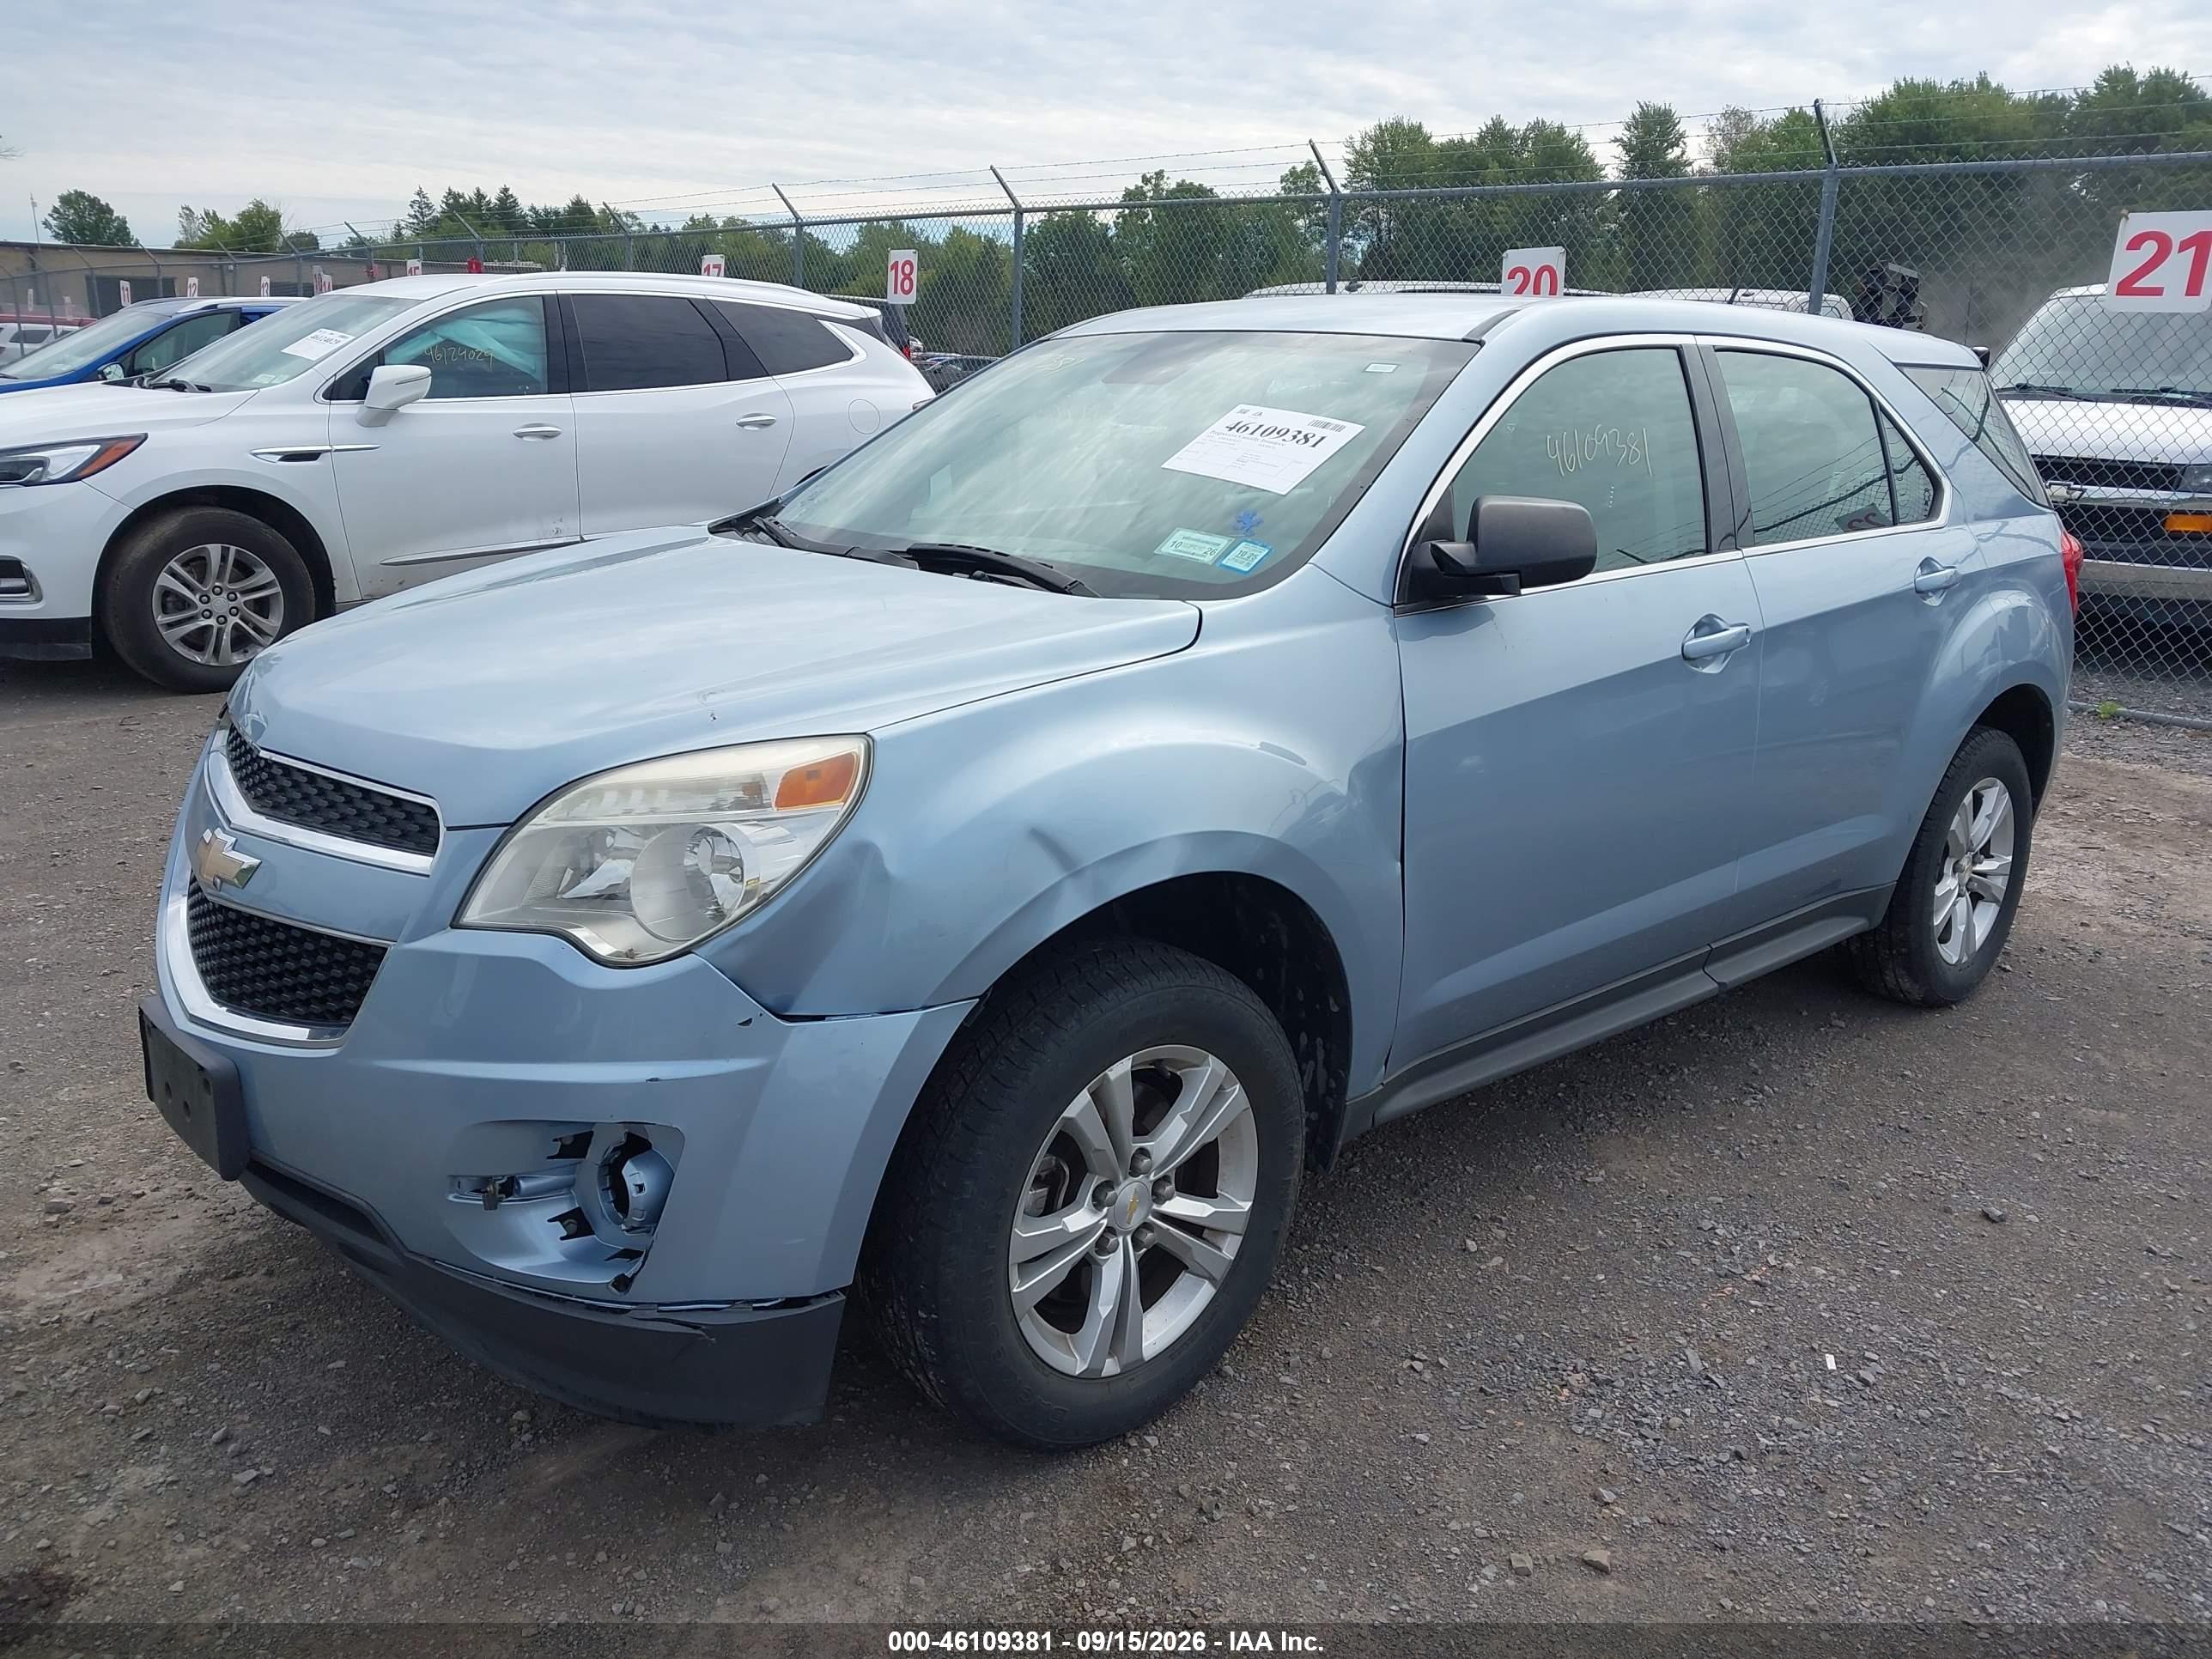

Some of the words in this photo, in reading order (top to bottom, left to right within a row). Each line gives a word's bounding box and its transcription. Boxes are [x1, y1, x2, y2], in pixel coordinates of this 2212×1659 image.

[890, 259, 915, 295] 18
[2115, 230, 2212, 296] 21
[122, 285, 130, 303] 11
[1225, 421, 1327, 448] 46109381
[1547, 424, 1653, 477] 46109381
